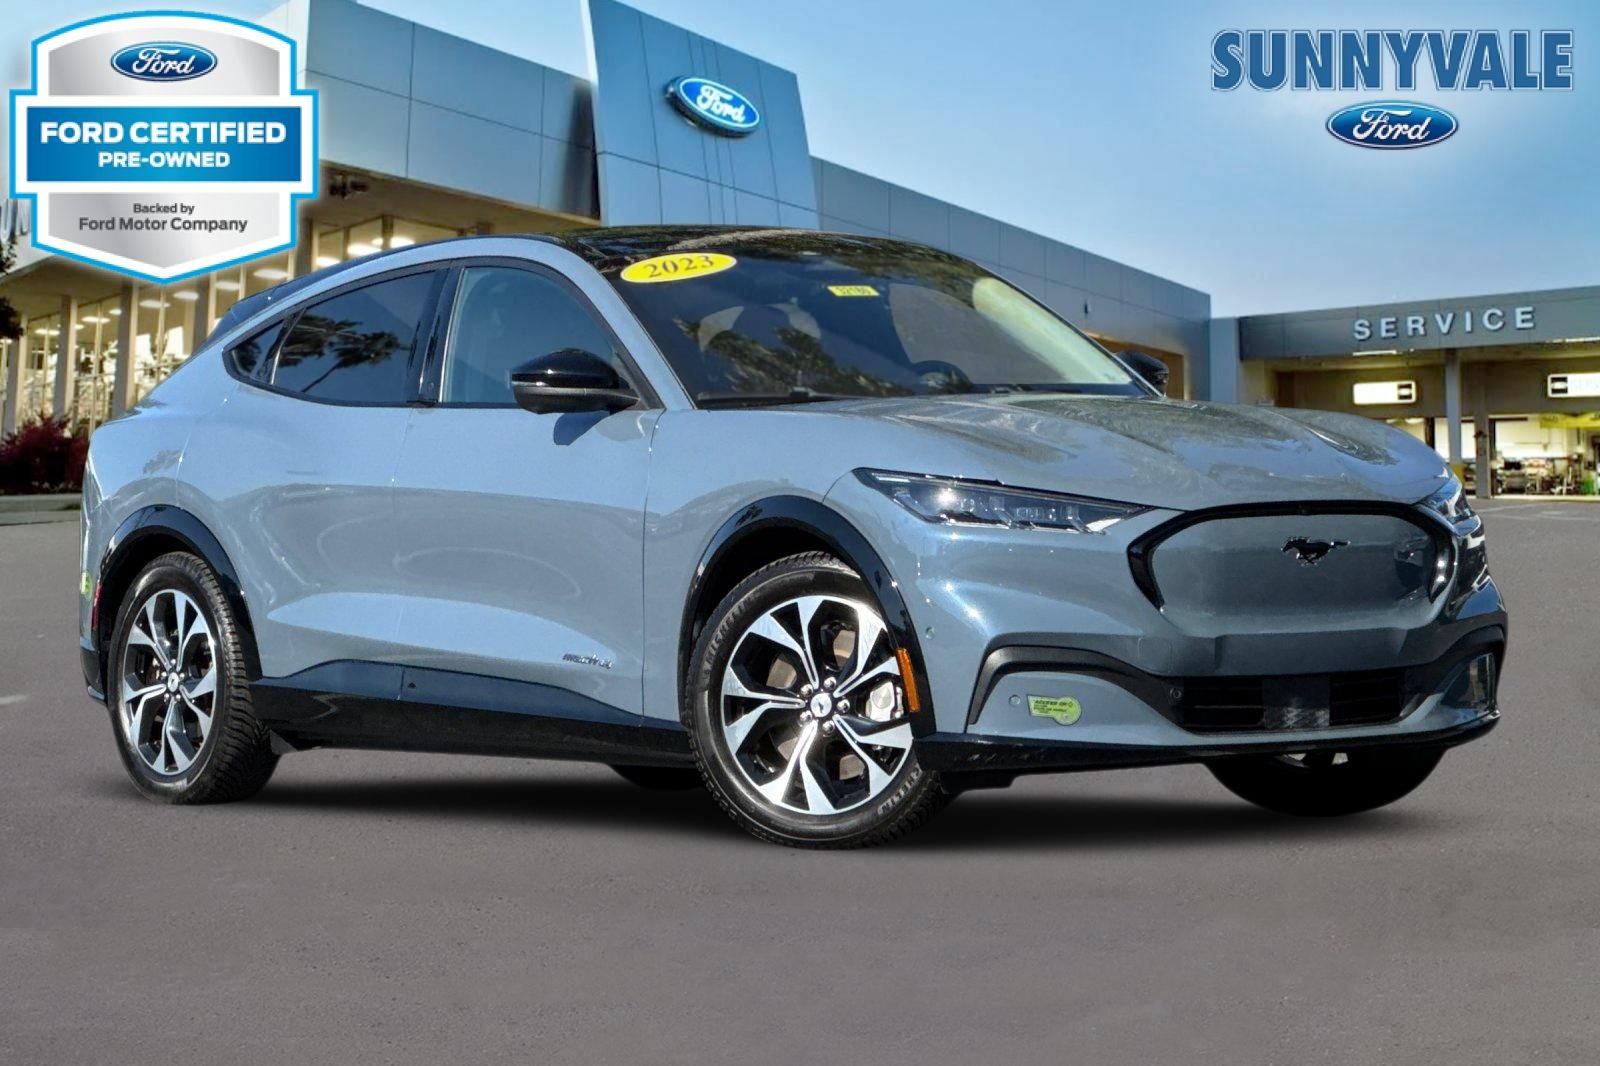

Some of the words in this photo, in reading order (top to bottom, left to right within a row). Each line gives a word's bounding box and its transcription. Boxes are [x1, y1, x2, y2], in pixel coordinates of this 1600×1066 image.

[697, 85, 746, 122] Ford
[643, 254, 715, 279] 2023
[1353, 306, 1535, 340] SERVICE
